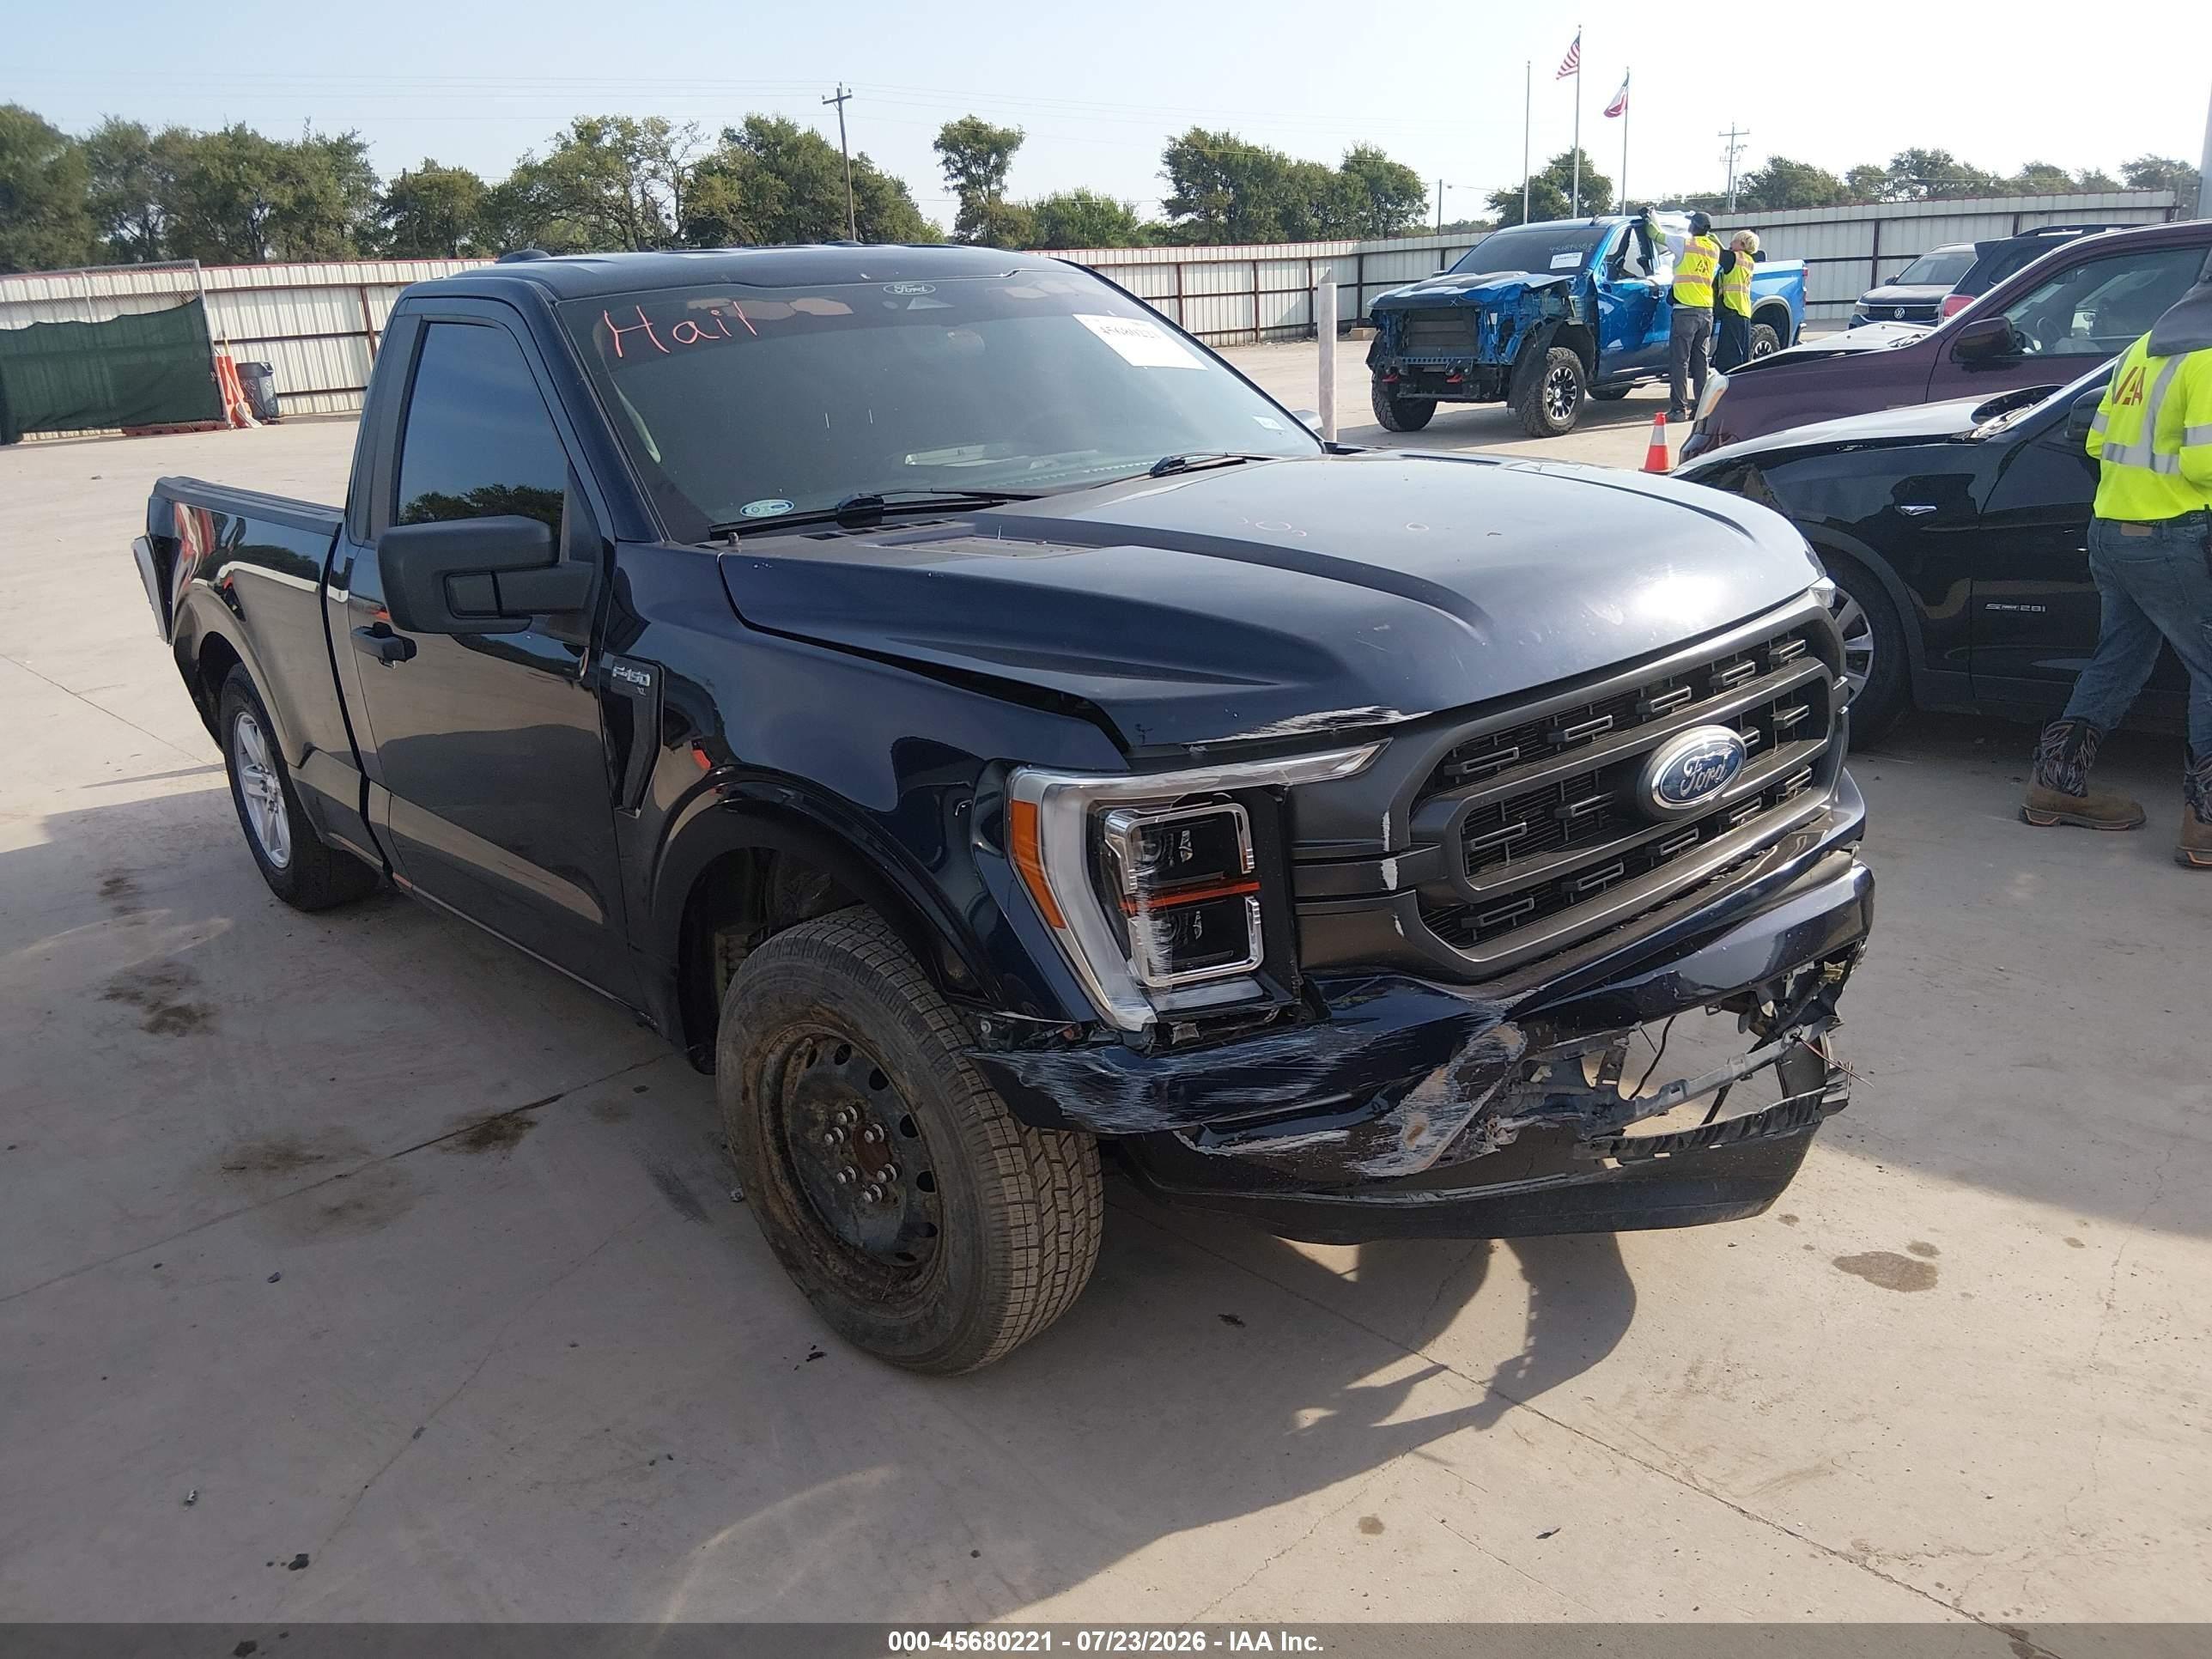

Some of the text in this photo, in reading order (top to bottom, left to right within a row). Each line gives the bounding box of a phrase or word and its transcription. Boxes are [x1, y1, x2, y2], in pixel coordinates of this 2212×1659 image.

[893, 283, 928, 294] Ford
[604, 301, 757, 358] Hail
[611, 665, 651, 687] F-150
[1680, 746, 1735, 798] Ford
